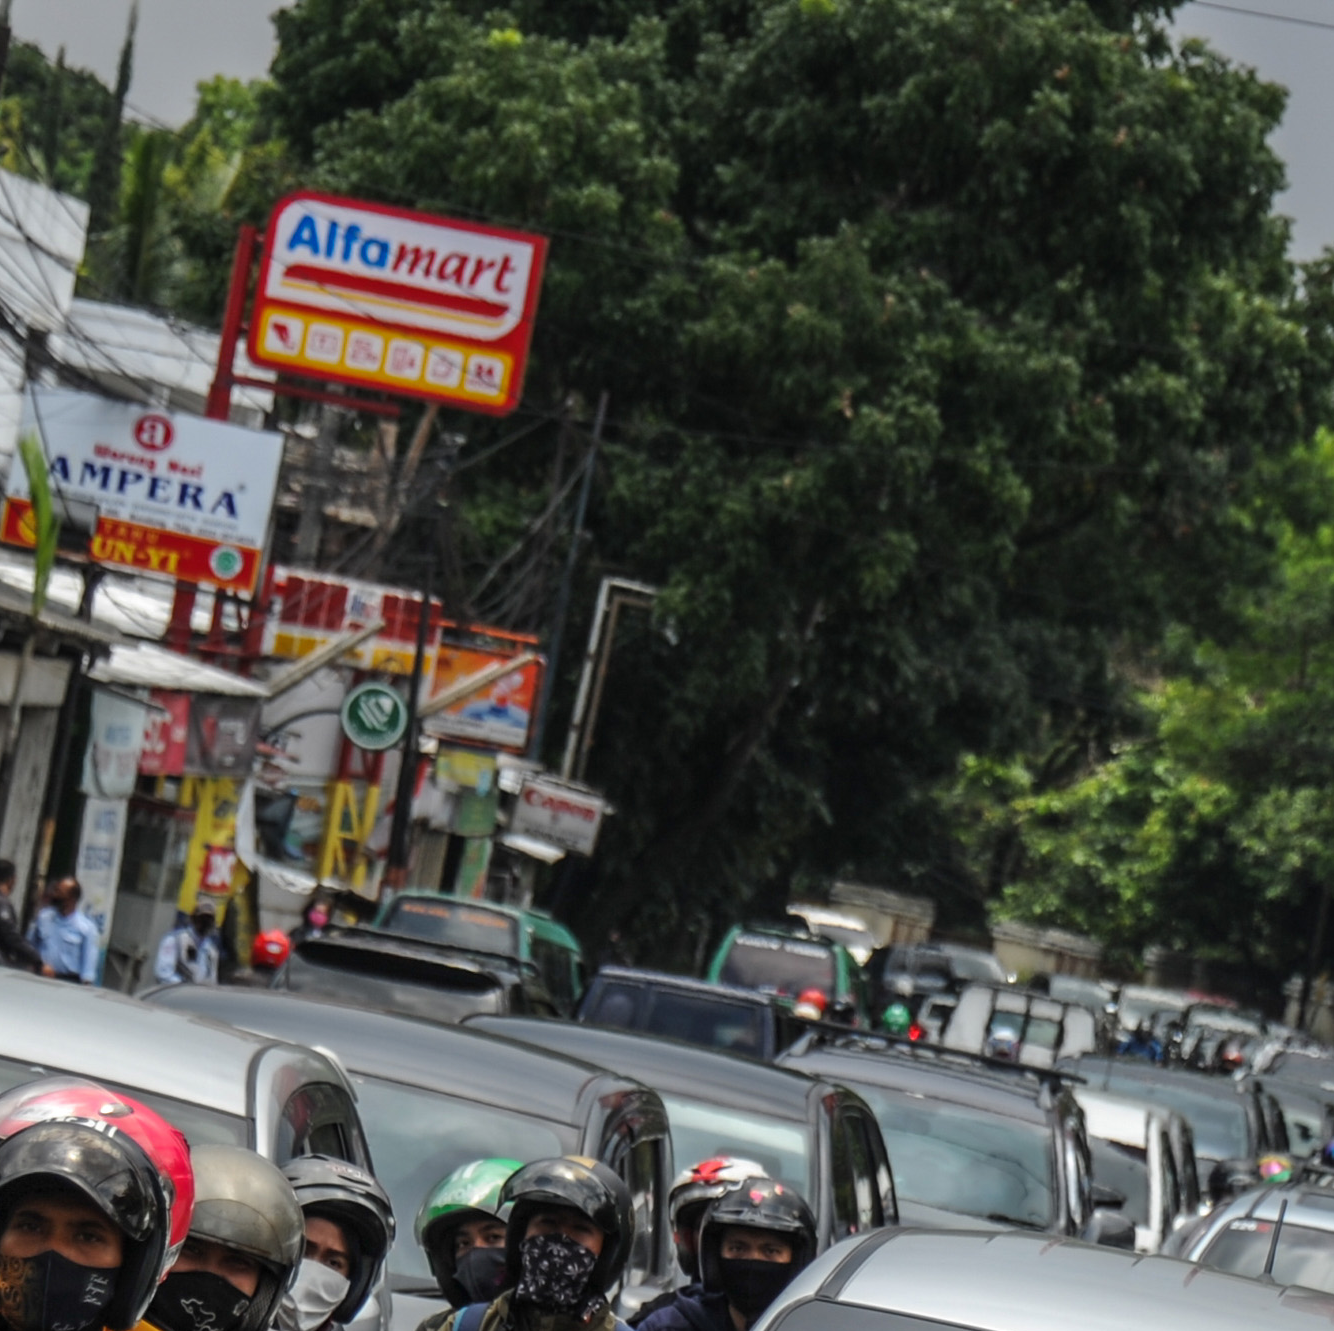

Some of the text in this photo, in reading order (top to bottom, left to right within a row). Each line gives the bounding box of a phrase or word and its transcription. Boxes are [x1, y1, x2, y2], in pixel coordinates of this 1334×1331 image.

[287, 213, 518, 294] Alfamart
[50, 455, 238, 519] AMPERA
[90, 535, 180, 574] UN-YI
